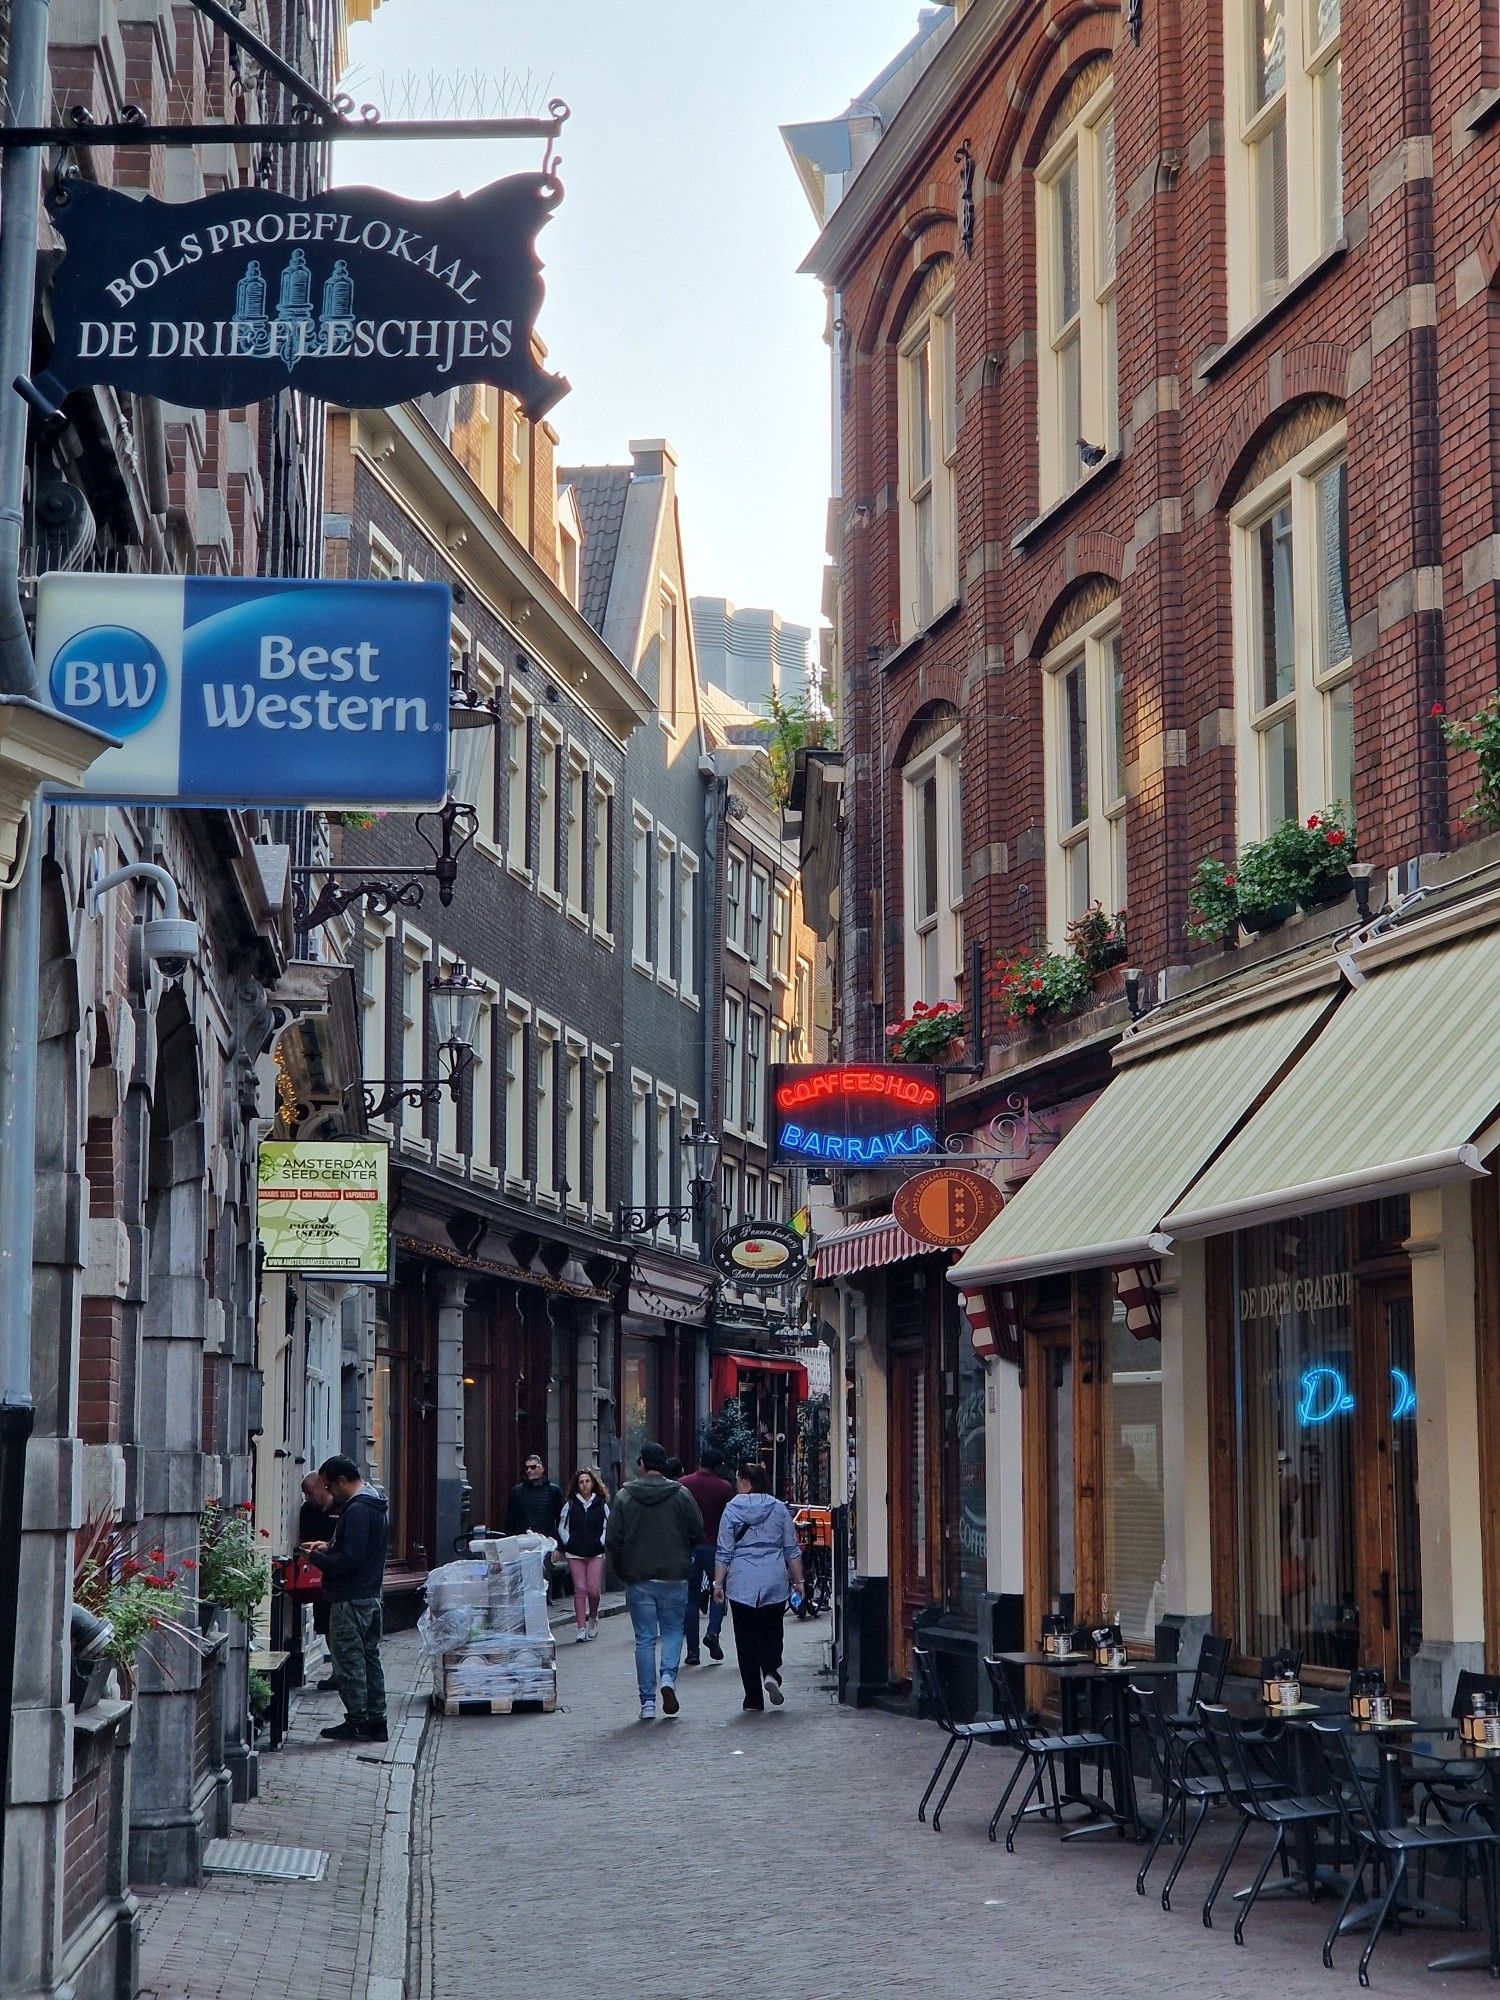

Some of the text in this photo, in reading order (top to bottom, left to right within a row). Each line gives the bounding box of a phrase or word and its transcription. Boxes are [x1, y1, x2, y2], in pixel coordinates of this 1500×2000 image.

[105, 212, 482, 308] BOLS PROEFLOKAAL
[78, 319, 513, 373] DE DRIE FLESCHJES
[259, 635, 380, 683] Best
[63, 660, 157, 709] BW
[202, 683, 430, 732] Western
[777, 1071, 936, 1108] COFFEESHOP
[780, 1123, 934, 1162] BARRAKA
[282, 1158, 377, 1169] AMSTERDAM
[282, 1170, 378, 1180] SEED CENTER
[280, 1190, 297, 1199] SEEDS
[301, 1190, 340, 1199] CBD PRODUCTS
[345, 1191, 376, 1200] VAPORIZERS
[913, 1171, 985, 1215] AMSTERDAMSCHE LEKKERNIJ
[721, 1231, 737, 1247] De
[920, 1226, 978, 1245] STROOPWAFELS
[732, 1268, 790, 1282] Dutch pancakes
[1240, 1287, 1257, 1321] DE
[1300, 1368, 1355, 1425] De
